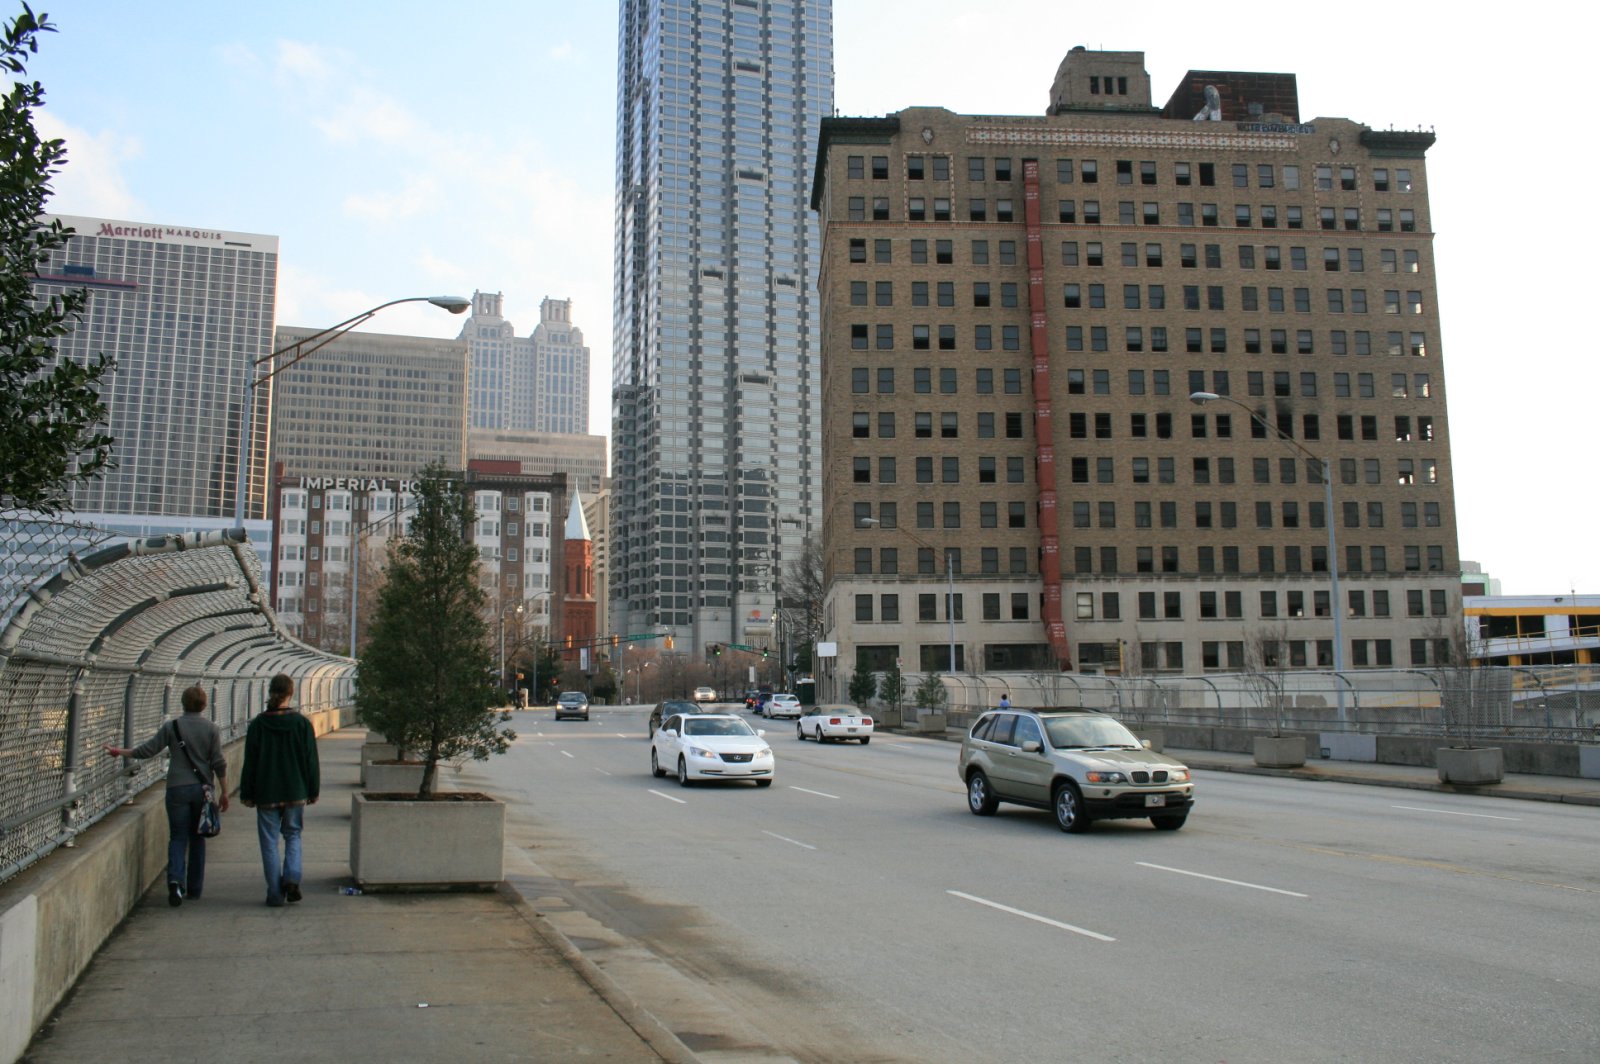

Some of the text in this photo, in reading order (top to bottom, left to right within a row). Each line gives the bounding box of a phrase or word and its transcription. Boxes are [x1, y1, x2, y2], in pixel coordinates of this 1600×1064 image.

[96, 222, 222, 240] Marriott MARQUIS
[299, 476, 392, 492] IMPERIAL
